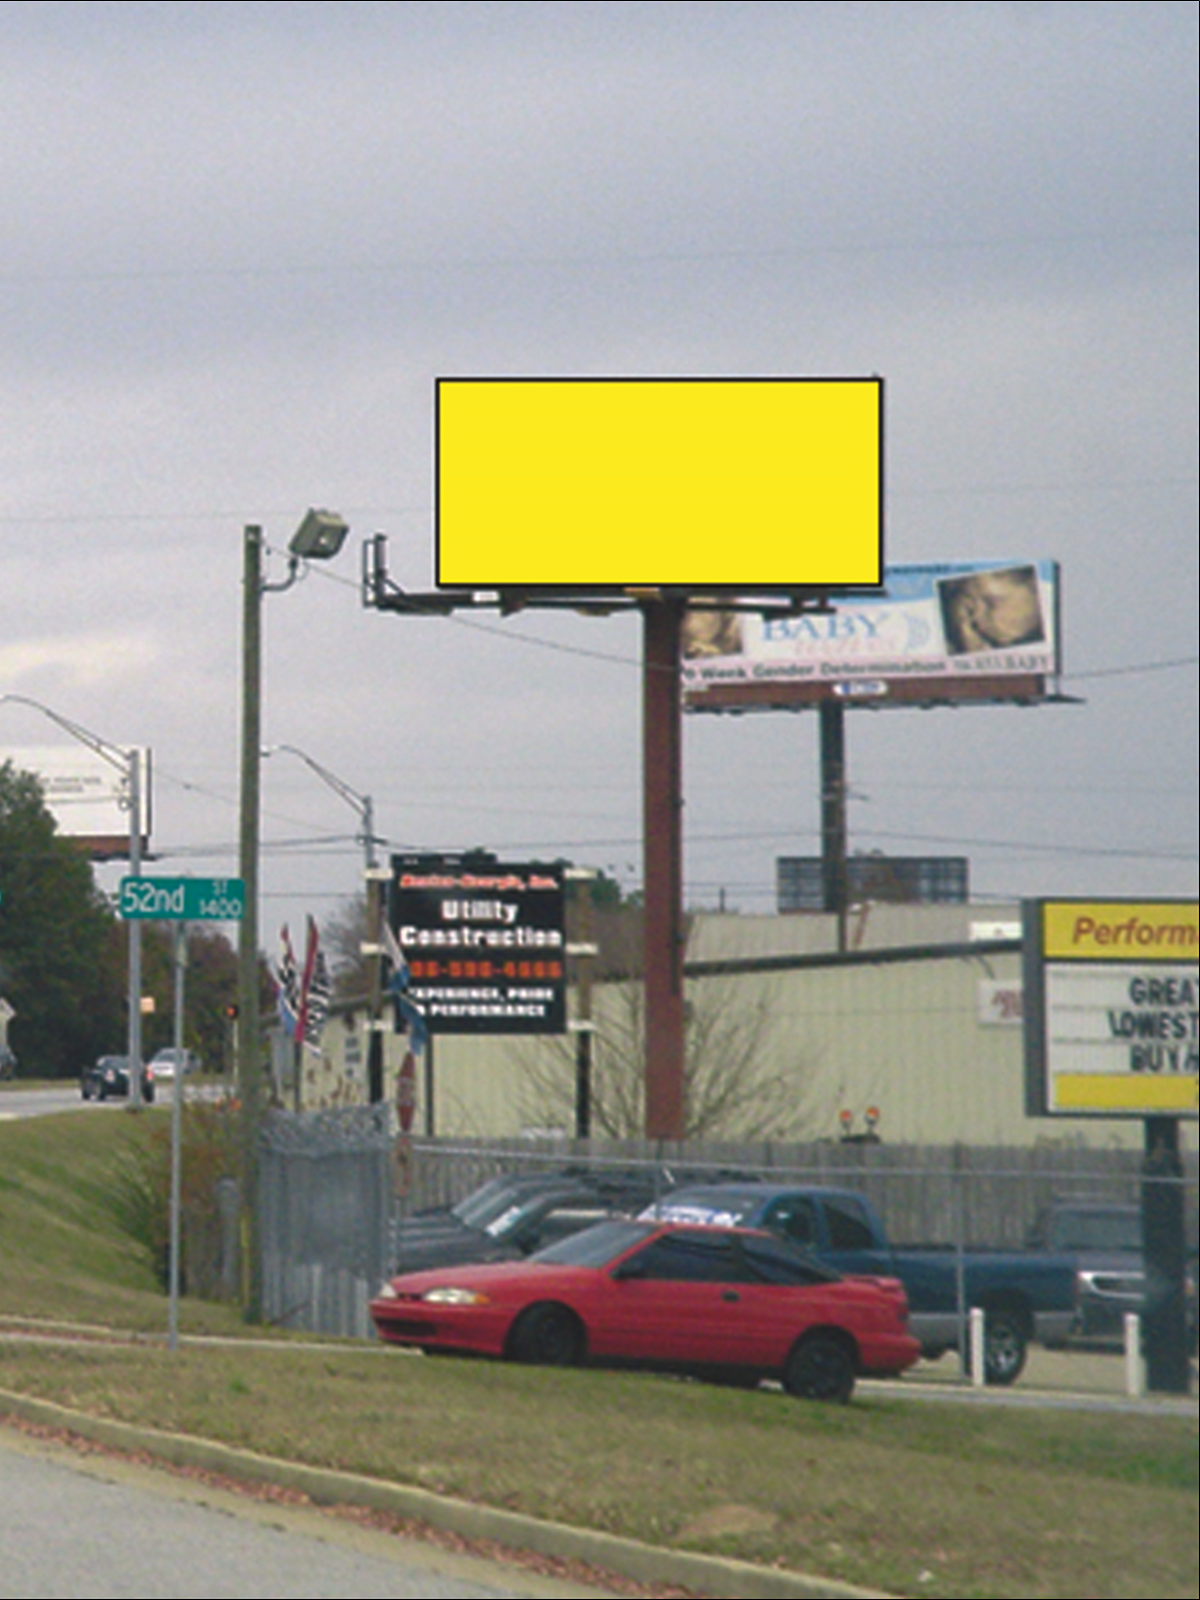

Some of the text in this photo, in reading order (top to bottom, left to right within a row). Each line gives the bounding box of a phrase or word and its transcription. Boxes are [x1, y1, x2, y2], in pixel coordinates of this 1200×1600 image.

[762, 611, 891, 641] BABY
[753, 663, 815, 678] Gender
[123, 882, 186, 914] 52nd
[199, 897, 243, 917] 1400
[441, 900, 519, 923] Utility
[400, 926, 563, 946] Construction
[1072, 916, 1199, 946] Perform
[408, 987, 505, 1002] XPERIENCE,
[1128, 976, 1199, 1006] GREA
[430, 1003, 546, 1017] PERFORMANCE
[1107, 1010, 1199, 1040] LOWEST
[1129, 1044, 1181, 1072] BUY
